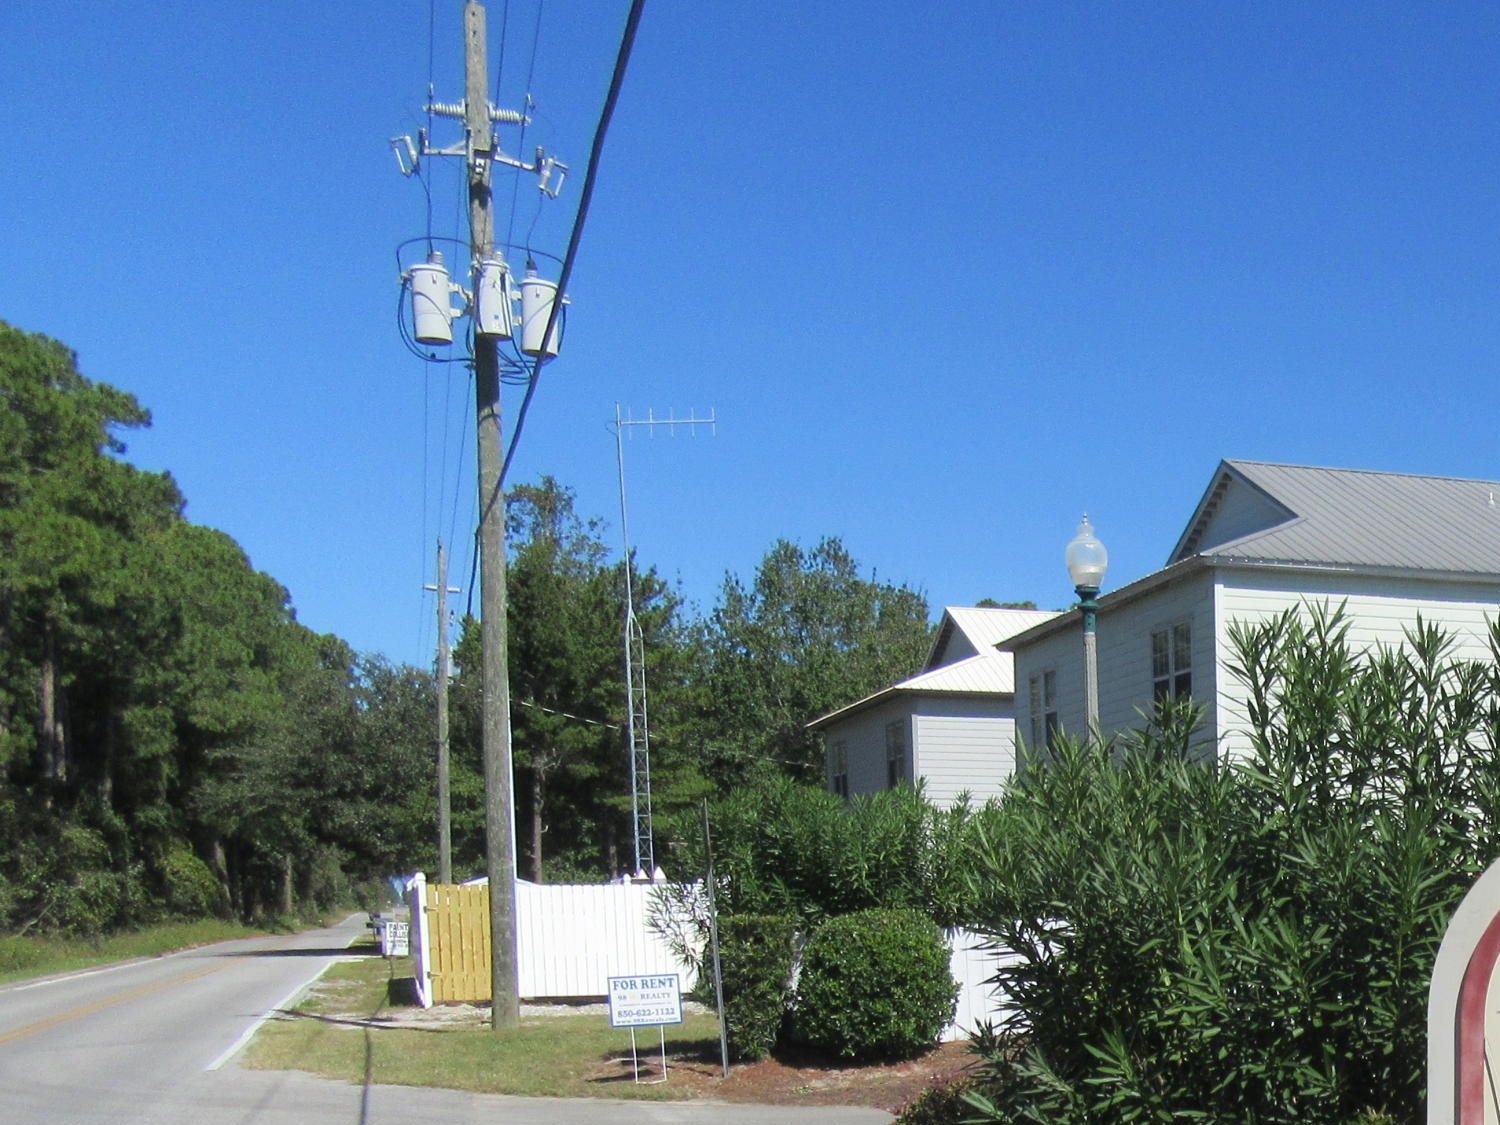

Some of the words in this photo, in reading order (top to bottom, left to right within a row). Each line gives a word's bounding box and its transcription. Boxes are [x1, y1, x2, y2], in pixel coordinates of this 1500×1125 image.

[612, 979, 638, 991] FOR
[640, 977, 675, 990] RENT
[640, 992, 671, 1000] REALTY
[617, 1007, 675, 1018] 850-622-1122
